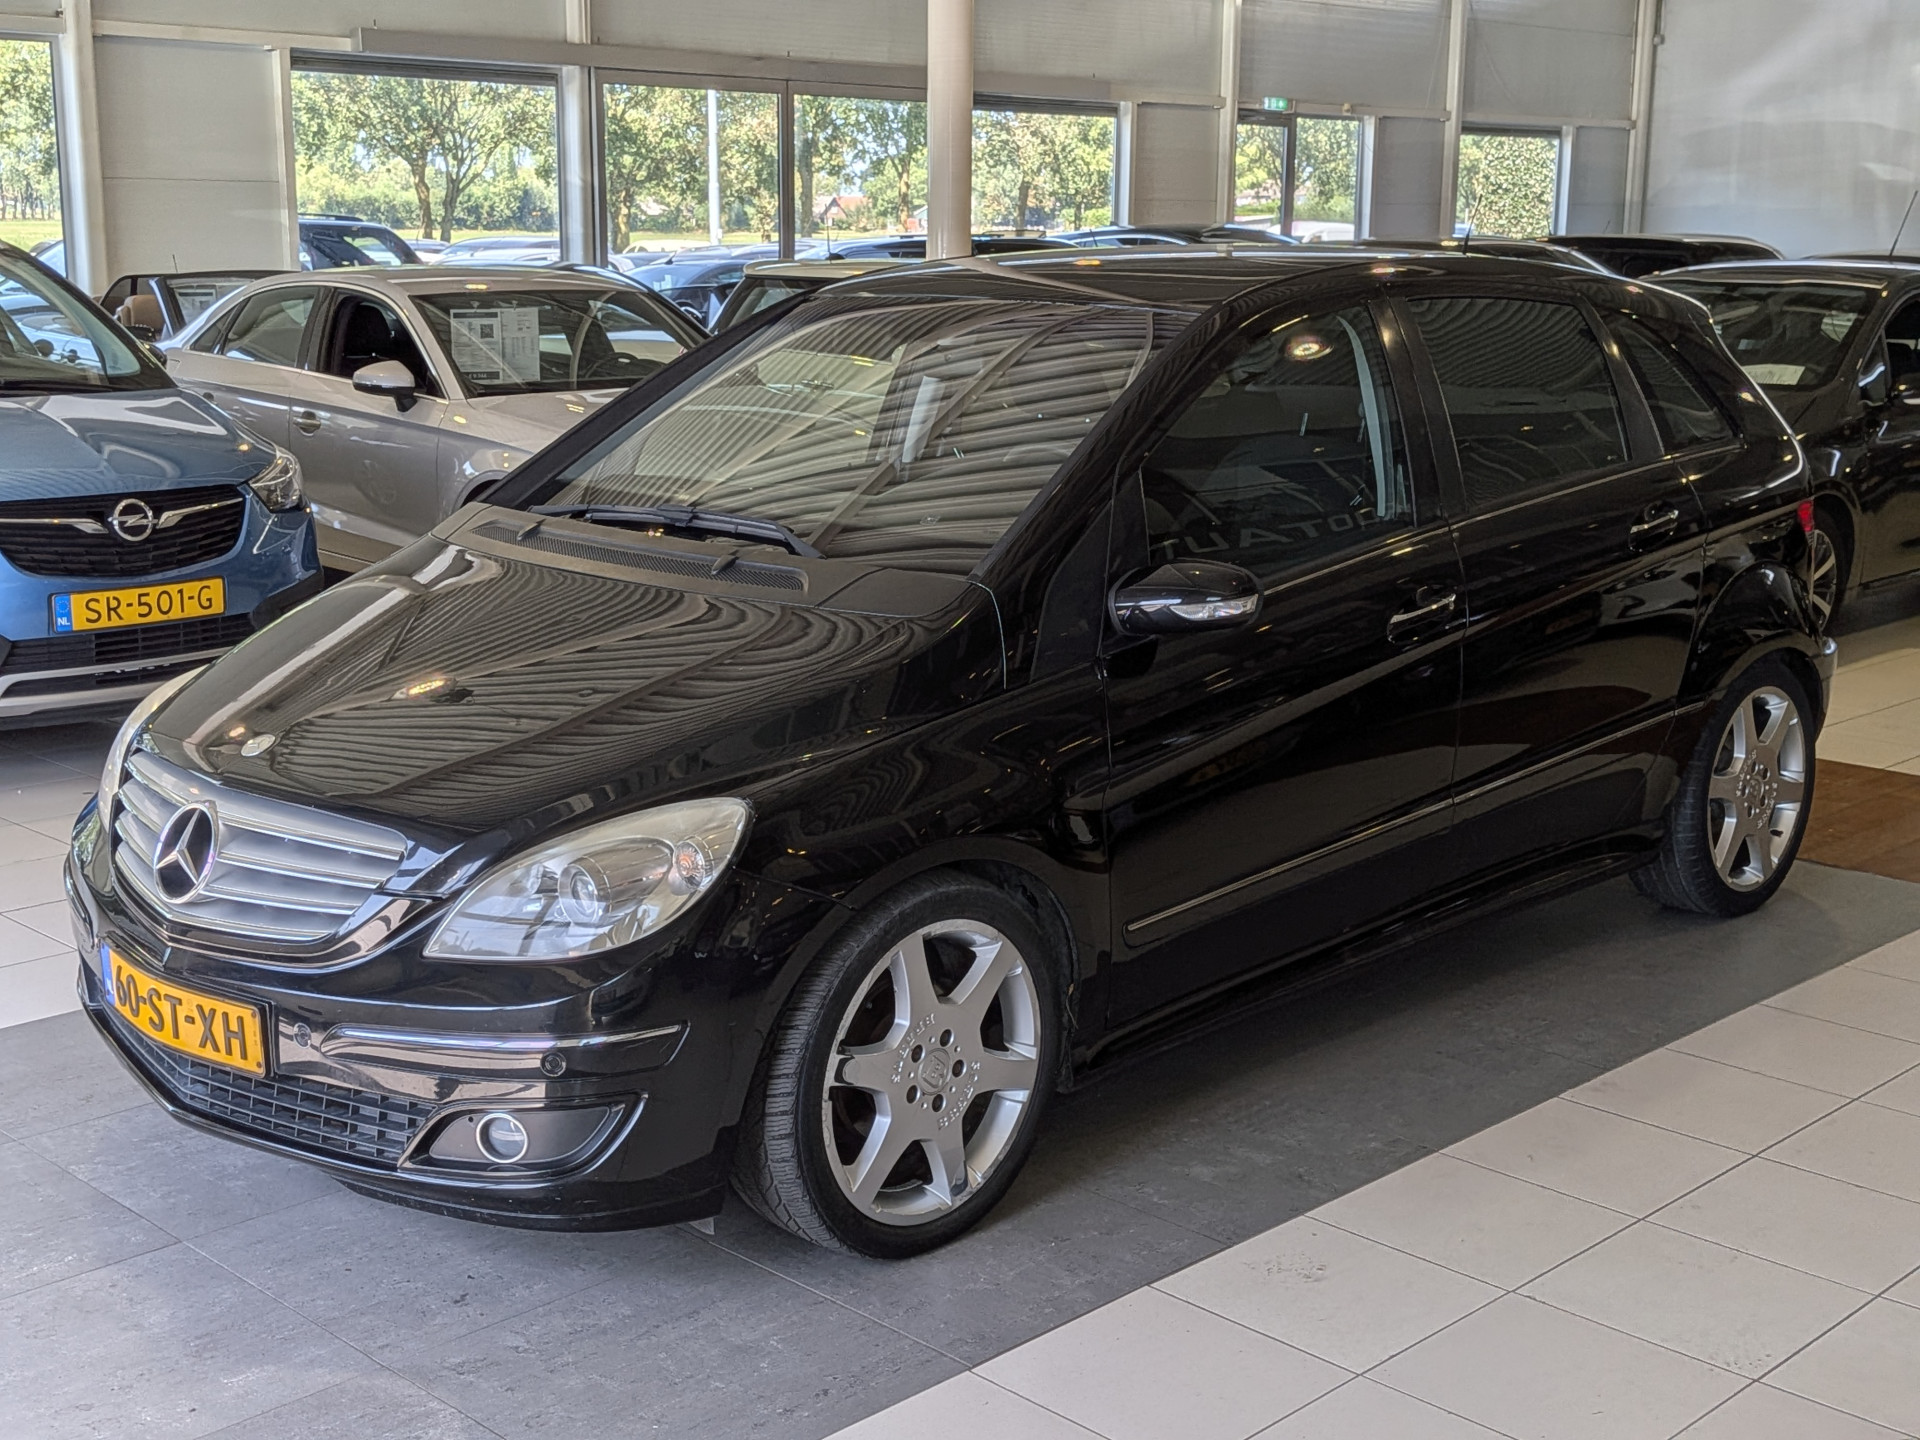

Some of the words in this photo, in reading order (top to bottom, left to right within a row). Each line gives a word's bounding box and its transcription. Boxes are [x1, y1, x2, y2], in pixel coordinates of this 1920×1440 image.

[57, 616, 70, 627] NL
[85, 585, 213, 624] SR-501-G
[115, 965, 248, 1060] 60-ST-XH
